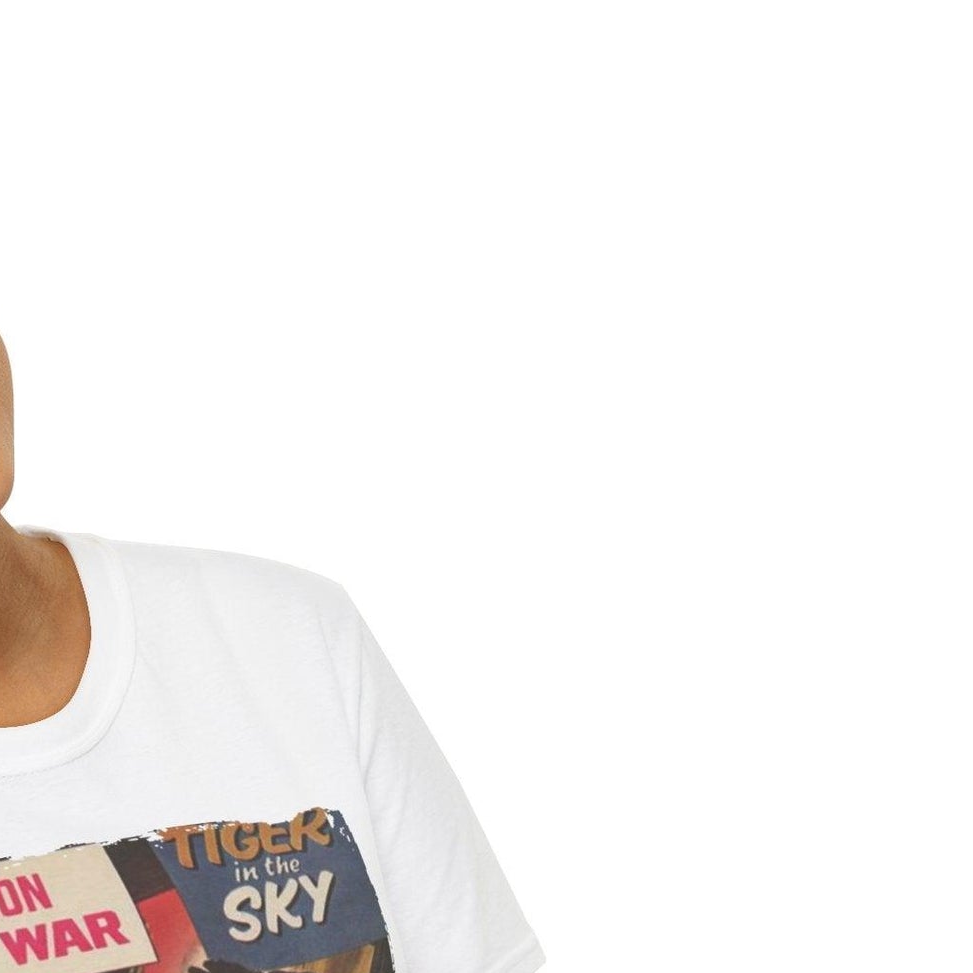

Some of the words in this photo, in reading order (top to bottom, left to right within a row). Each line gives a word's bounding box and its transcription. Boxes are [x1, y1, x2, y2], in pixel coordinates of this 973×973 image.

[158, 807, 332, 869] TIGER
[234, 861, 259, 883] in
[265, 857, 301, 877] the
[223, 870, 334, 942] SKY
